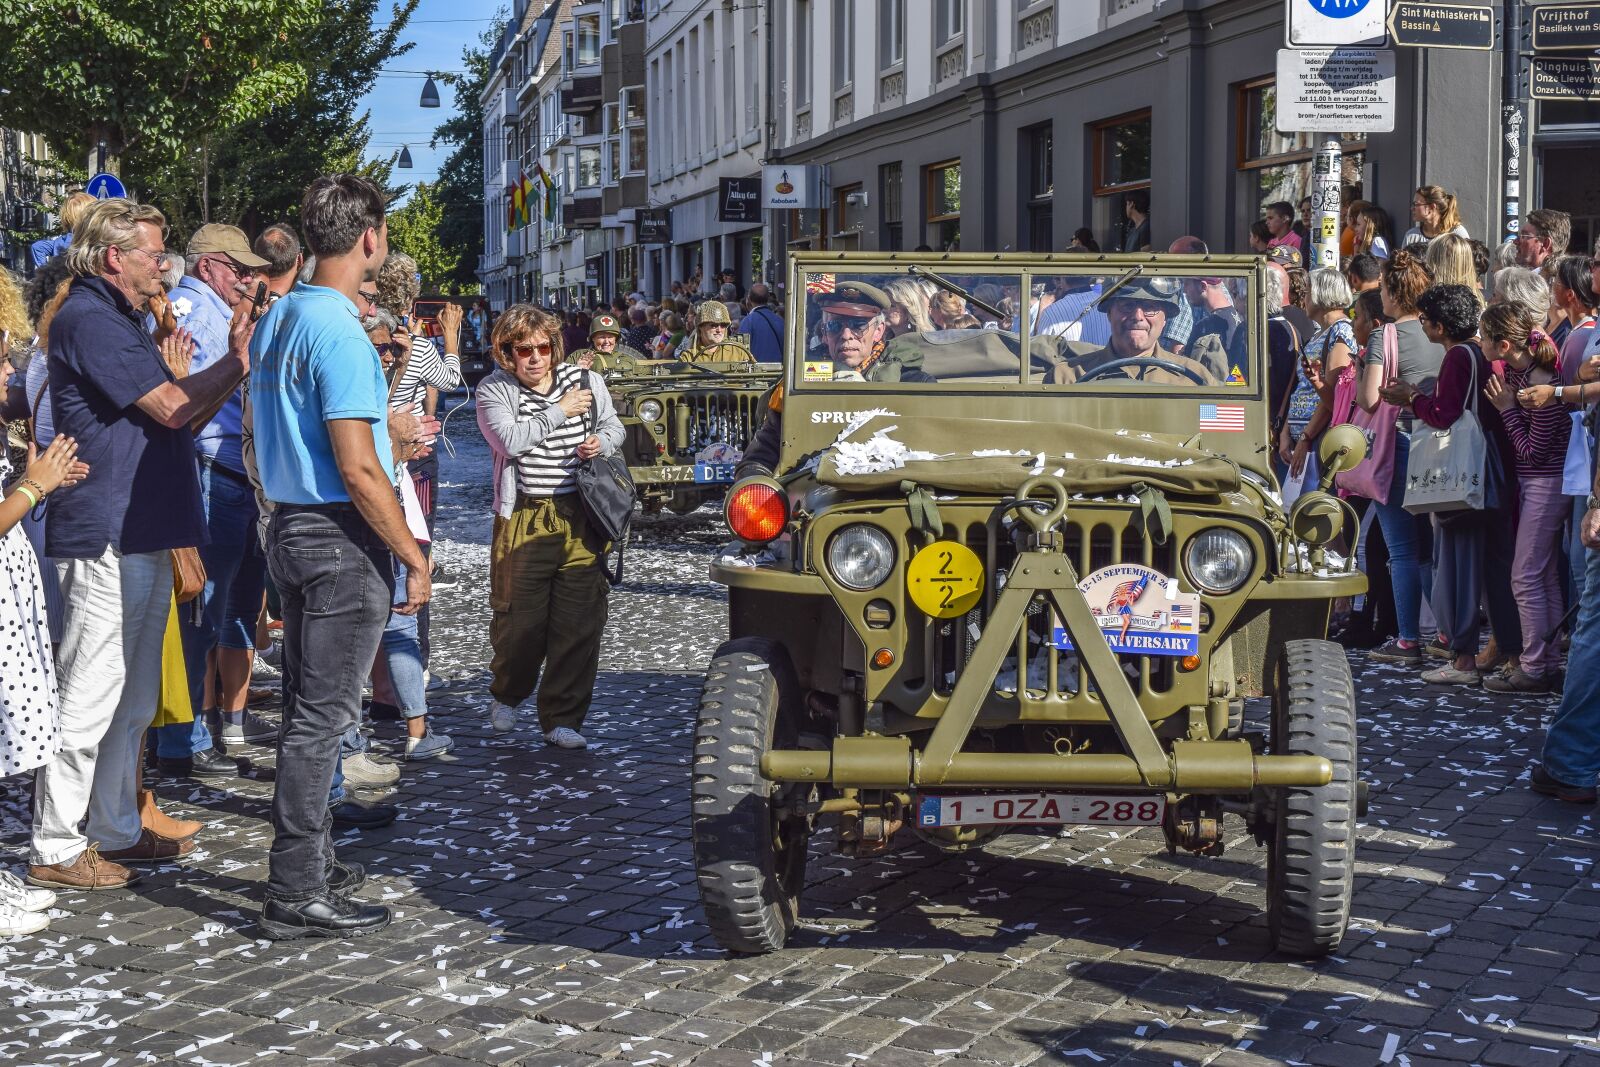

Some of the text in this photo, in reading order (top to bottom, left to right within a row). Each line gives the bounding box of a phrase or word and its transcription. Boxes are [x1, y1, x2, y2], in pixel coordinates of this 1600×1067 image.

[1401, 8, 1478, 21] Sint Mathiaskerk
[1540, 11, 1589, 23] Vrijthof
[1401, 20, 1431, 30] Bassin
[1539, 24, 1573, 33] Basiliek
[1536, 74, 1558, 83] Onze
[1561, 75, 1585, 83] Lieve
[1536, 86, 1554, 94] Onze
[730, 191, 757, 200] Alley Cat
[939, 551, 953, 574] 2
[1103, 567, 1158, 582] SEPTEMBER
[1158, 578, 1169, 590] 20
[940, 585, 954, 609] 2
[923, 815, 936, 824] B
